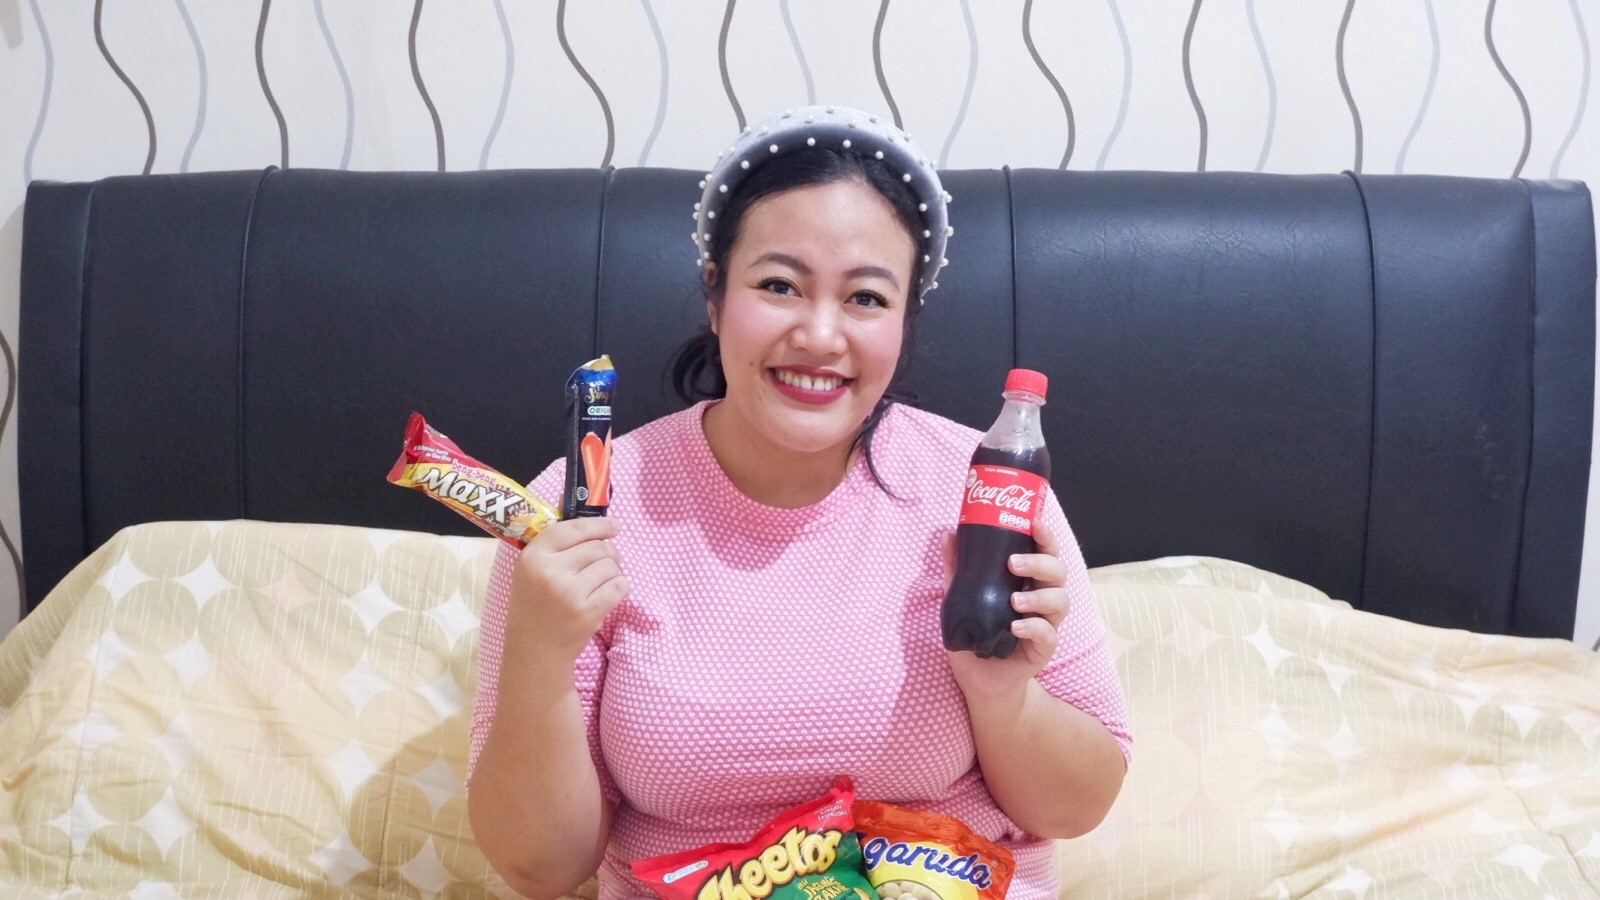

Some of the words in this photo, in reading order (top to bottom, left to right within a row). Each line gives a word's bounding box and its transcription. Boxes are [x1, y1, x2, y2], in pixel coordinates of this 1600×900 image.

[452, 459, 496, 487] beng-beng
[966, 480, 1036, 512] Coca-Cola
[865, 837, 991, 890] garuda
